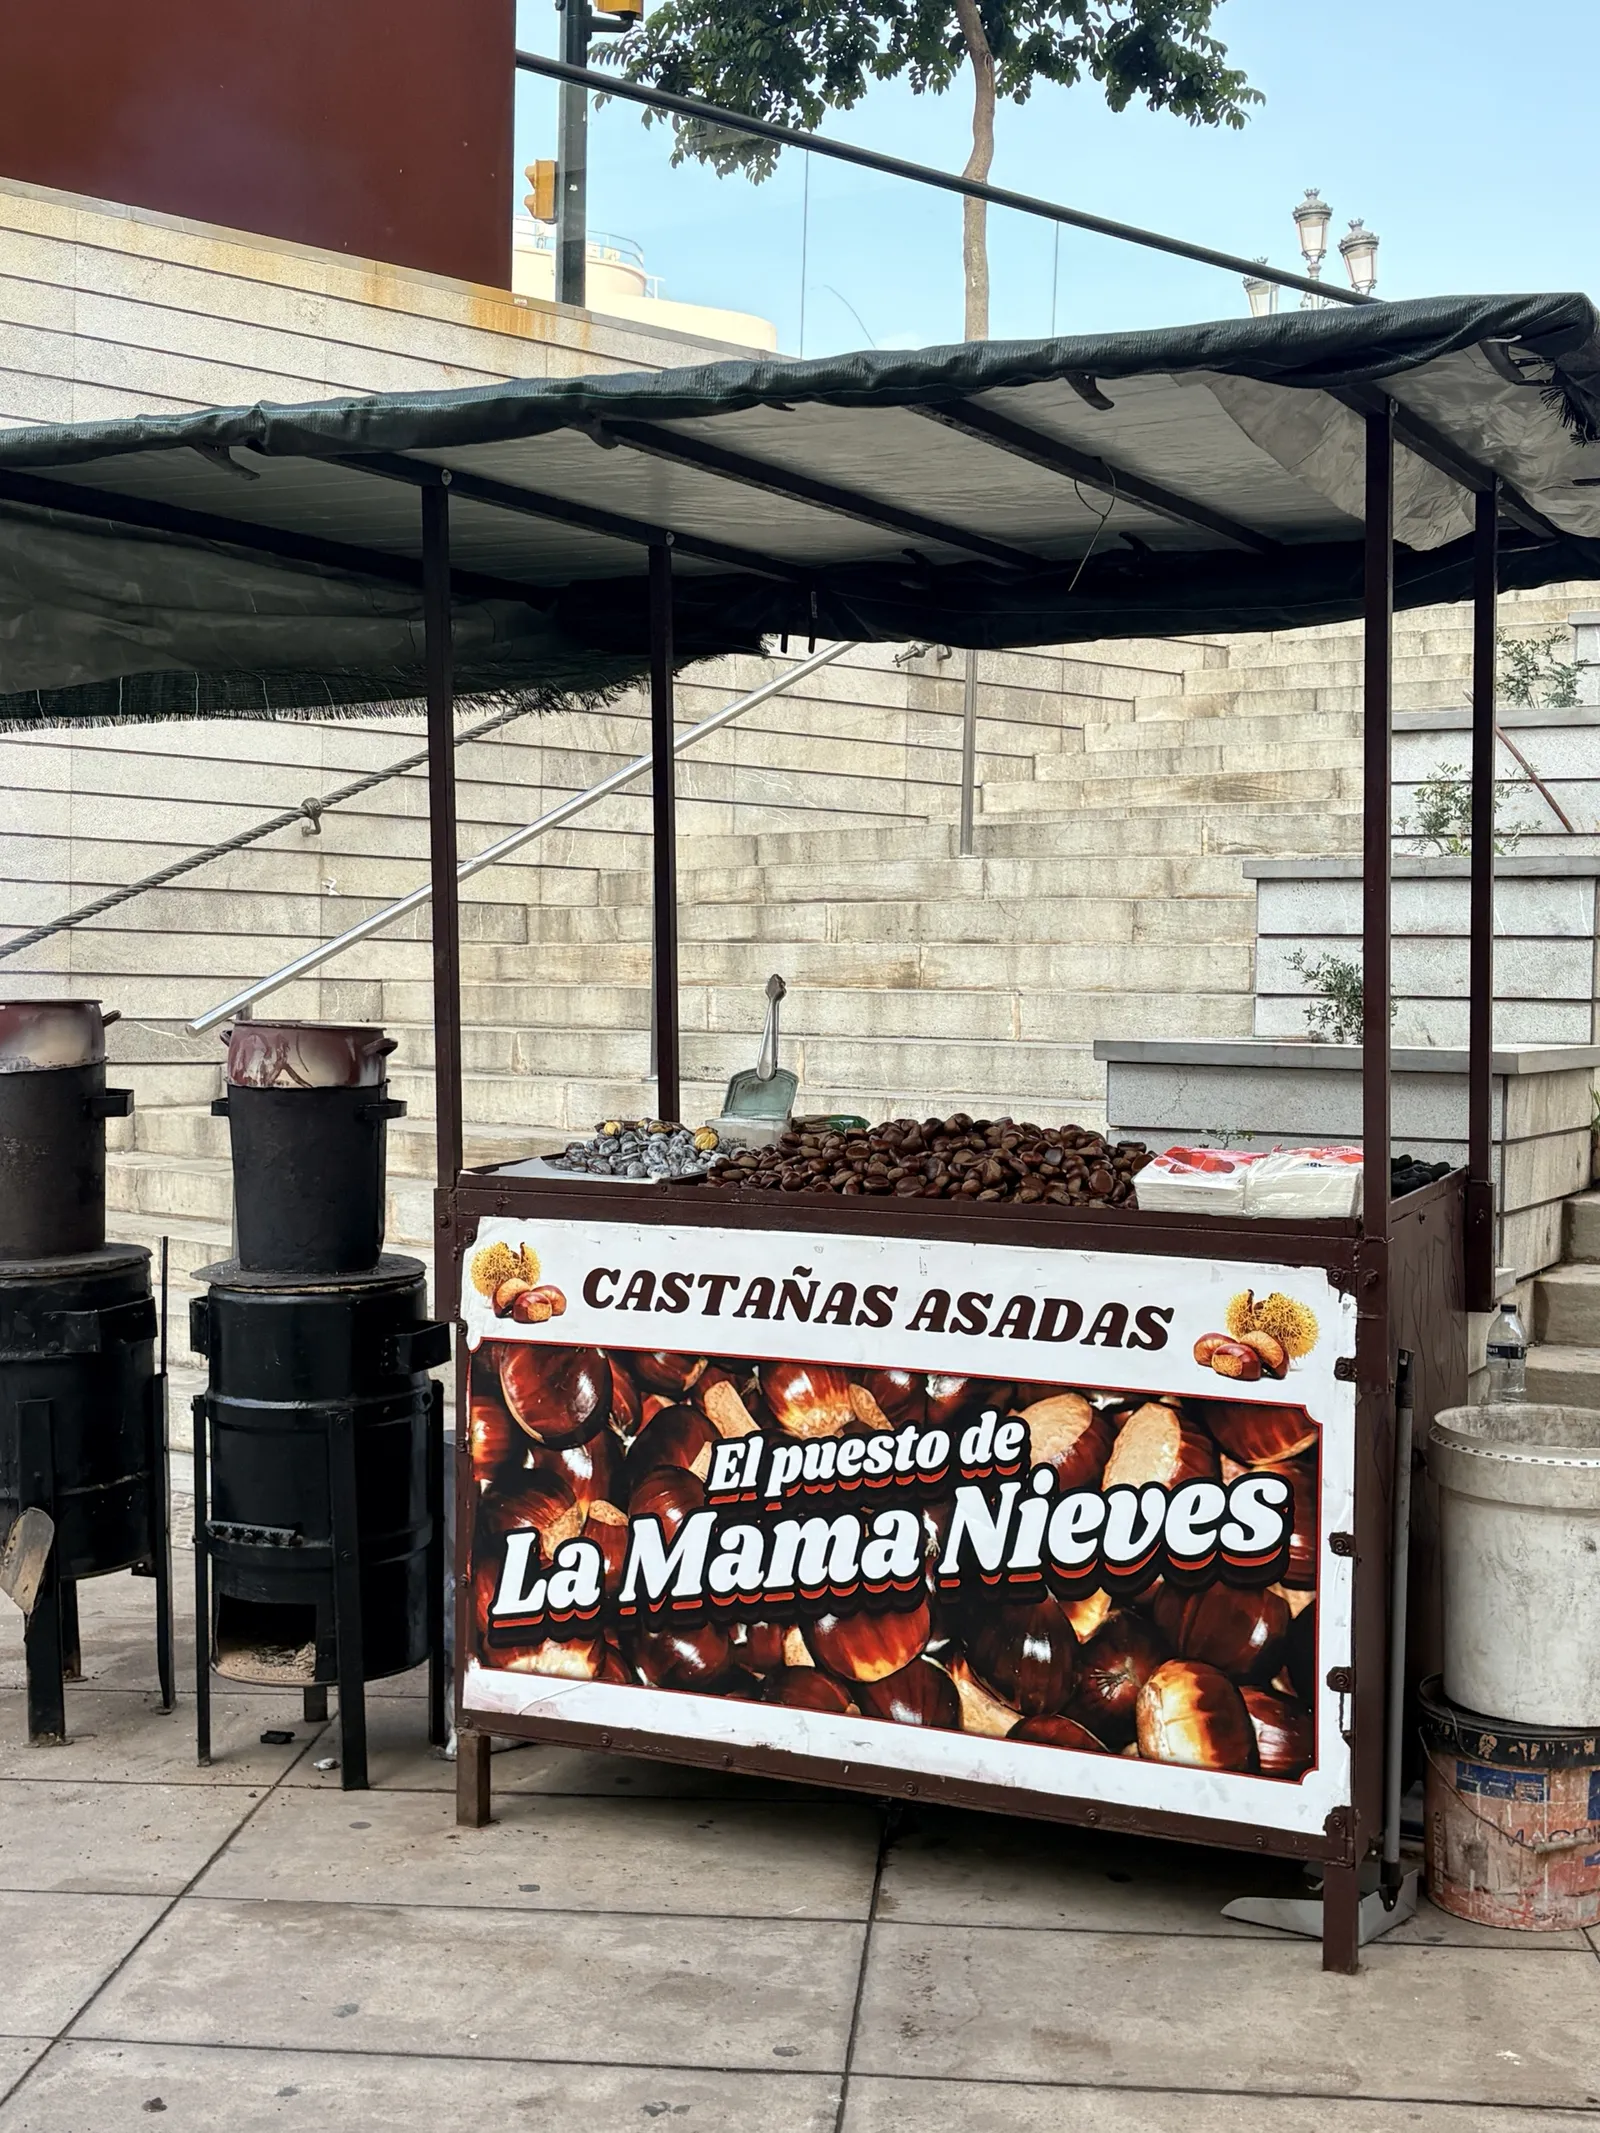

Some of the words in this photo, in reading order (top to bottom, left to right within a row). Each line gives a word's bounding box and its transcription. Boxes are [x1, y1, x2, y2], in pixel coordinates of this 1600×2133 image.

[582, 1266, 899, 1328] CASTAÑAS
[905, 1288, 1175, 1351] ASADAS
[708, 1436, 765, 1492] El
[764, 1425, 950, 1498] puesto
[959, 1410, 1025, 1465] de
[492, 1532, 601, 1615] La
[618, 1510, 920, 1602] Mama
[938, 1468, 1288, 1574] Nieves
